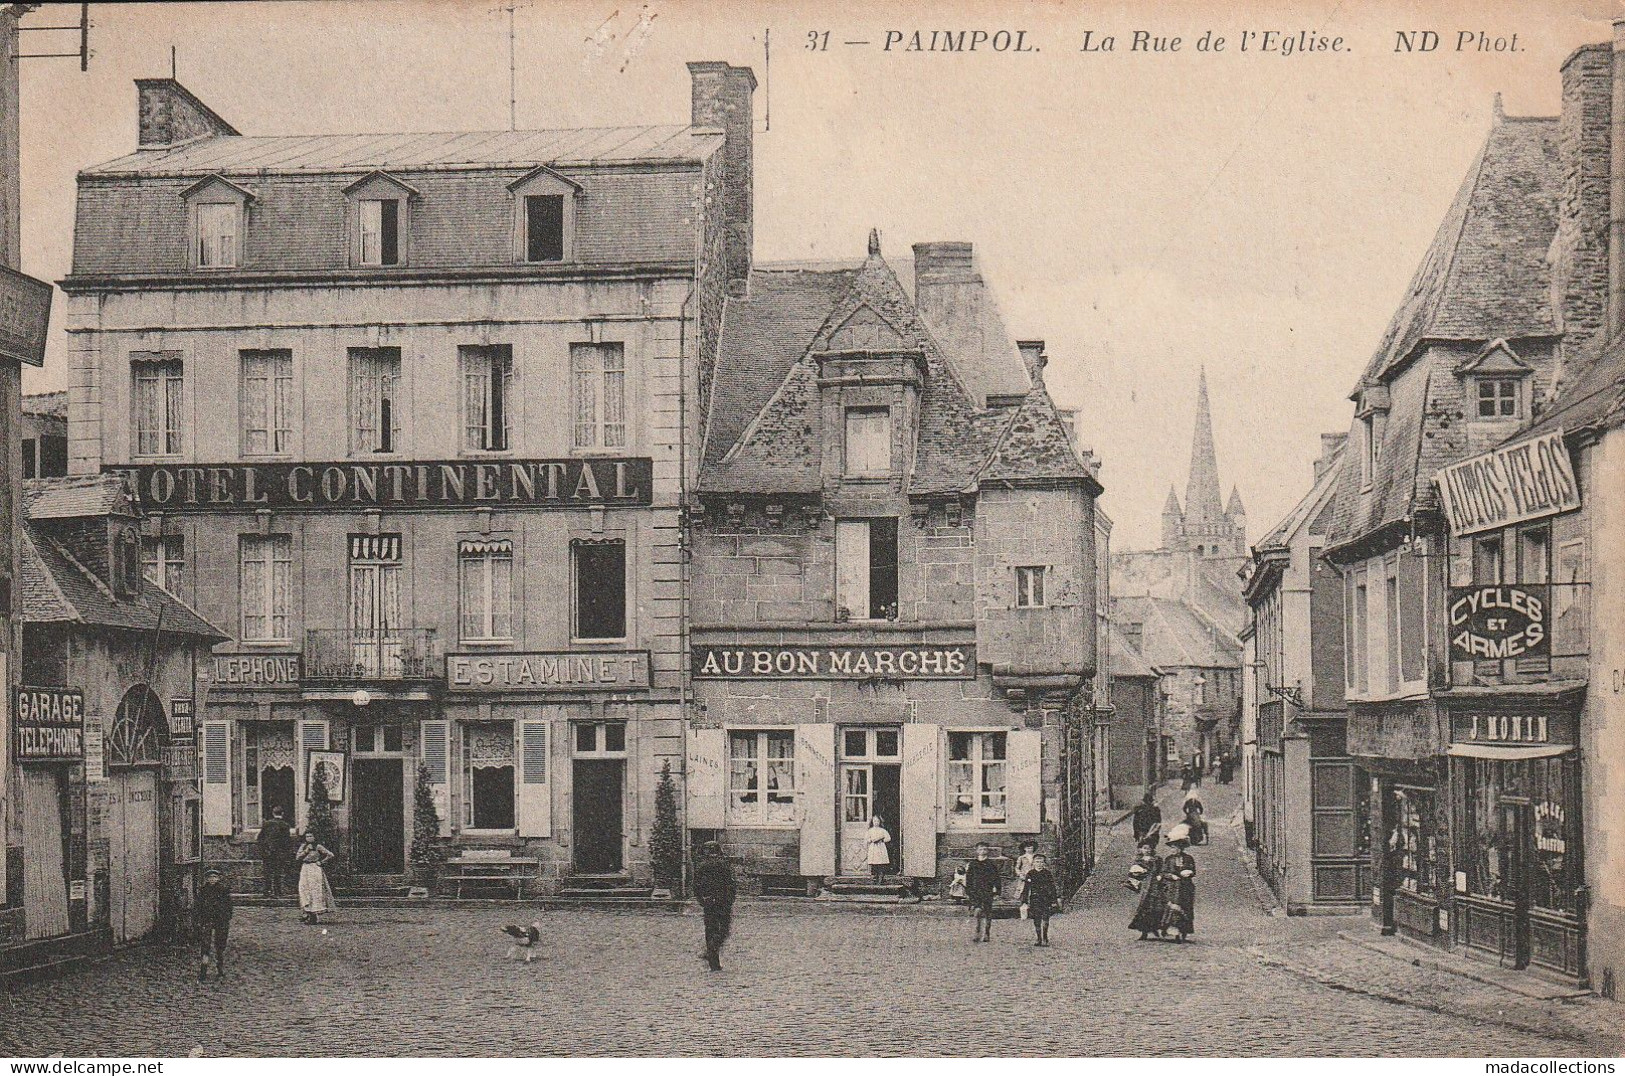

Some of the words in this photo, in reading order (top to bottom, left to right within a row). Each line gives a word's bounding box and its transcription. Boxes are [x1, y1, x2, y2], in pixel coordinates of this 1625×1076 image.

[288, 460, 640, 503] CONTINENTAL
[1451, 588, 1543, 626] CYCLES
[1486, 618, 1508, 631] ET
[1453, 622, 1544, 658] ARMES
[212, 658, 299, 684] LEPHONE
[452, 657, 640, 685] ESTAMINET
[701, 651, 746, 675] AU
[752, 651, 820, 675] BON
[829, 648, 965, 674] MARCHÉ
[19, 692, 82, 722] GARAGE
[19, 727, 82, 756] TELEPHONE
[689, 753, 719, 769] LAINES
